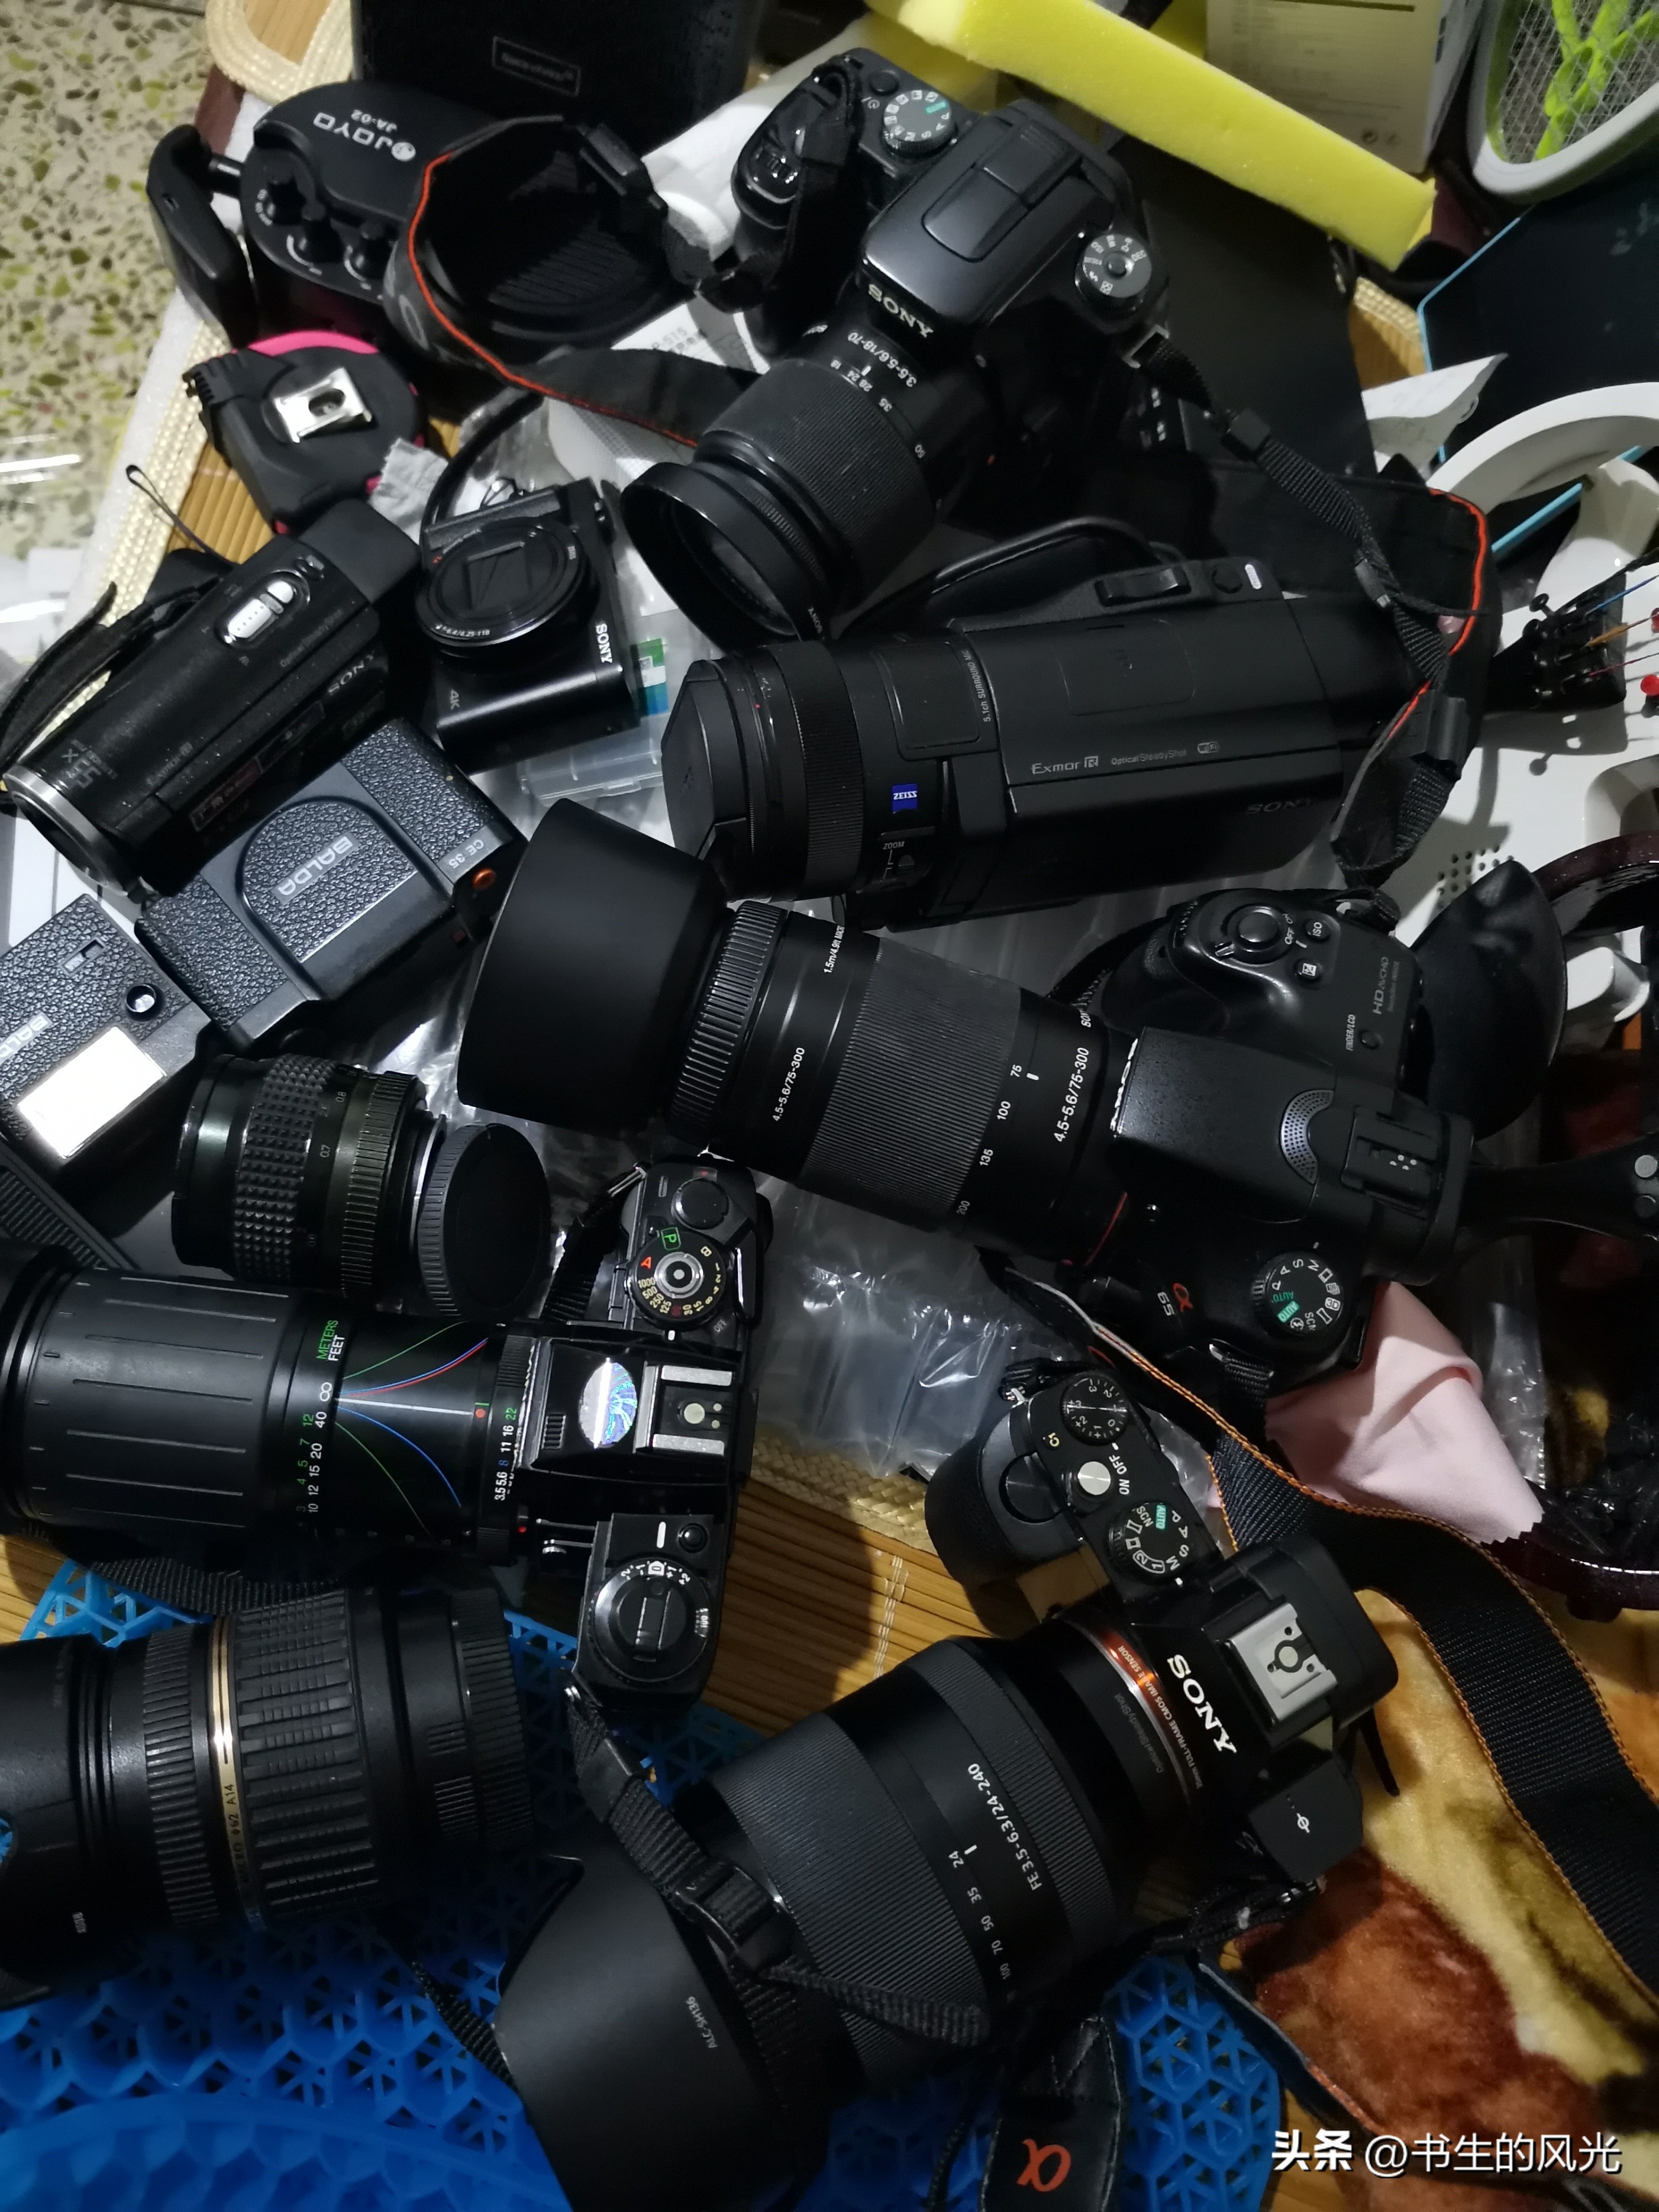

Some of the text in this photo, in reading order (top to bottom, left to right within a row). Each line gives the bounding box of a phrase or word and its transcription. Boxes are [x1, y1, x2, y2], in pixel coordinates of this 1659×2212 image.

[351, 109, 397, 133] JA-02
[313, 112, 393, 150] JOYO
[869, 283, 934, 338] SONY
[847, 332, 917, 388] 3.5-5.6/18-70
[859, 379, 873, 392] 28
[879, 398, 893, 412] 35
[596, 623, 613, 664] SONY
[328, 650, 375, 696] SONY
[967, 662, 986, 699] SURROUND
[450, 689, 460, 710] 4K
[1031, 762, 1080, 775] Exmor
[893, 790, 918, 800] ZEISS
[448, 838, 485, 869] CE 35
[883, 841, 905, 850] ZOOM
[277, 836, 353, 896] BALDA
[1284, 927, 1295, 946] OFF
[1312, 921, 1323, 937] ISO
[823, 939, 841, 973] 1.5m/4.9ft
[0, 1014, 49, 1059] BALD
[1345, 1014, 1356, 1052] FINDER/LCD
[1009, 1064, 1022, 1078] 75
[772, 1047, 805, 1122] 4.5-5.6/75-300
[1054, 1047, 1090, 1143] 4.5-5.6/75-300
[997, 1101, 1011, 1121] 100
[979, 1148, 994, 1167] 135
[956, 1200, 971, 1215] 200
[664, 1233, 677, 1243] P
[641, 1256, 652, 1270] A
[1280, 1265, 1290, 1275] A
[1292, 1259, 1304, 1268] S
[1307, 1259, 1320, 1272] M
[638, 1276, 656, 1289] 1000
[1271, 1280, 1282, 1291] P
[642, 1286, 658, 1300] 500
[649, 1293, 664, 1309] 250
[660, 1300, 672, 1314] 125
[682, 1304, 693, 1316] 30
[693, 1300, 705, 1313] 15
[1157, 1292, 1175, 1317] 65
[1278, 1301, 1299, 1323] AUTO
[316, 1319, 339, 1360] METERS
[328, 1334, 346, 1362] FEET
[303, 1414, 314, 1427] 12
[314, 1411, 328, 1429] 40
[505, 1407, 517, 1421] 22
[502, 1424, 515, 1437] 16
[1048, 1432, 1060, 1447] C1
[310, 1442, 324, 1460] 20
[500, 1441, 512, 1453] 11
[309, 1464, 321, 1478] 15
[497, 1459, 509, 1468] 8
[1108, 1454, 1128, 1475] OFF
[308, 1484, 319, 1497] 12
[1118, 1478, 1130, 1495] ON
[307, 1503, 319, 1514] 10
[1137, 1505, 1154, 1527] SCN
[1156, 1505, 1166, 1529] AUTO
[1171, 1510, 1182, 1523] P
[1178, 1526, 1189, 1539] A
[1136, 1553, 1148, 1565] 2
[1179, 1544, 1190, 1558] S
[1166, 1555, 1181, 1571] M
[1117, 1645, 1142, 1673] SENSOR
[1137, 1670, 1159, 1698] IMAE
[1154, 1695, 1173, 1723] CMOS
[1166, 1654, 1238, 1753] SONY
[1169, 1719, 1196, 1768] FULL-FRAME
[224, 1784, 236, 1805] A14
[967, 1763, 1042, 1892] FE 3.5-6.3/24-240
[948, 1850, 964, 1869] 24
[966, 1886, 983, 1904] 35
[980, 1914, 995, 1932] 50
[990, 1939, 1004, 1955] 70
[999, 1962, 1012, 1981] 100
[686, 1996, 718, 2049] ALC-SH136
